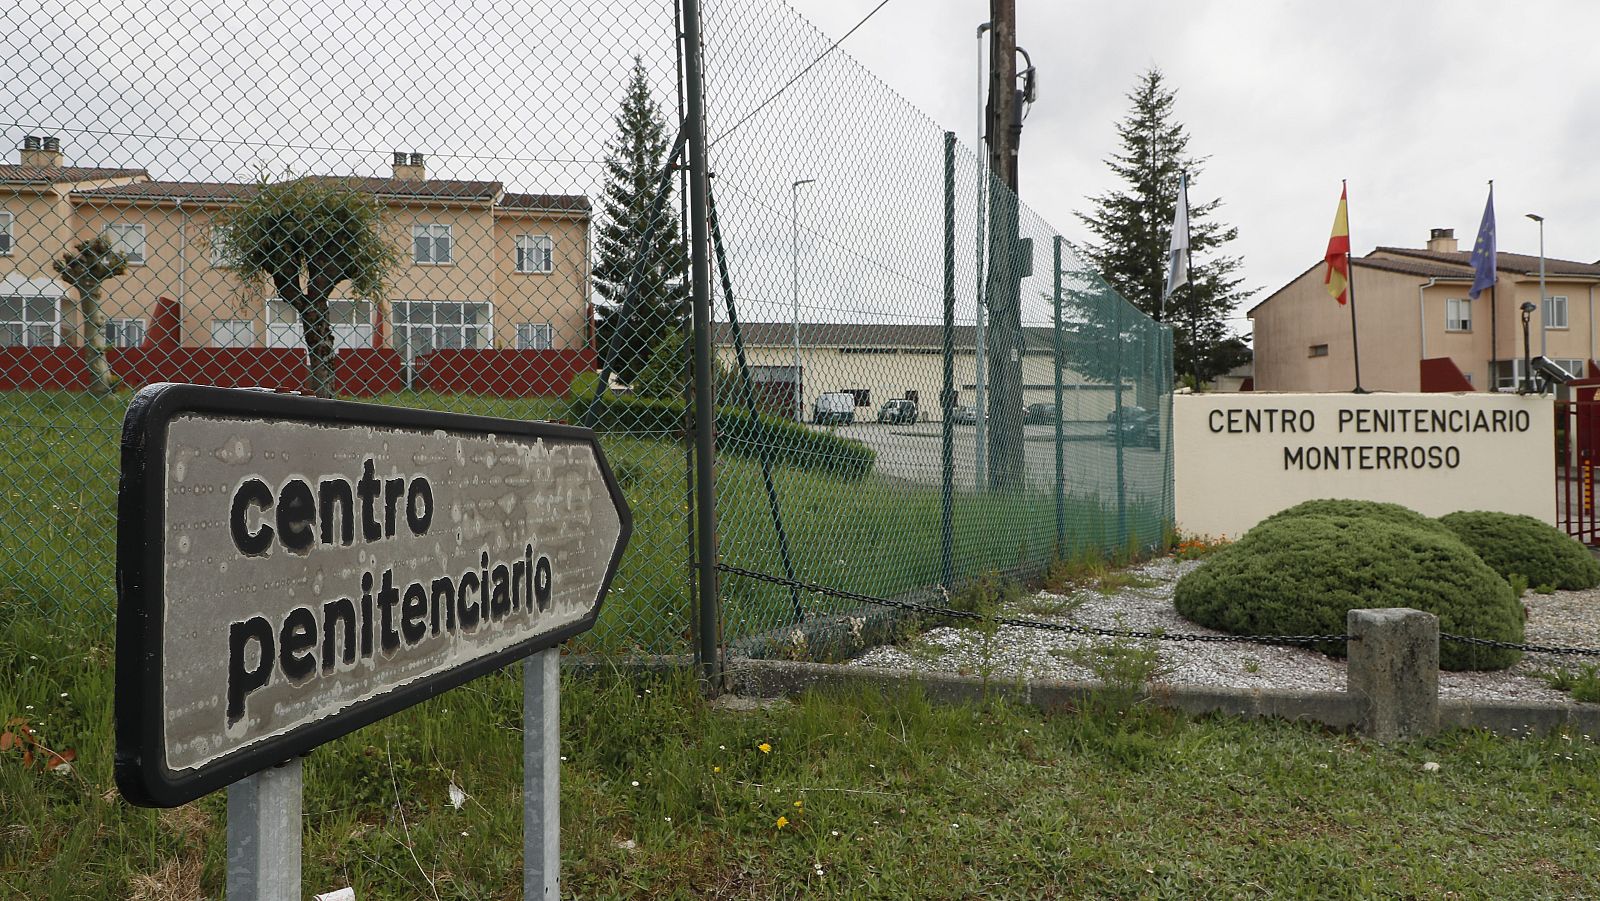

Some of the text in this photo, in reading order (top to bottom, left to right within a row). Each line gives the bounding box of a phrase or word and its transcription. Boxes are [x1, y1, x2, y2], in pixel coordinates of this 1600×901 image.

[1209, 409, 1531, 433] CENTRO PENITENCIARIO
[1284, 446, 1460, 470] MONTERROSO
[230, 458, 433, 557] centro
[227, 544, 552, 723] penitenciario
